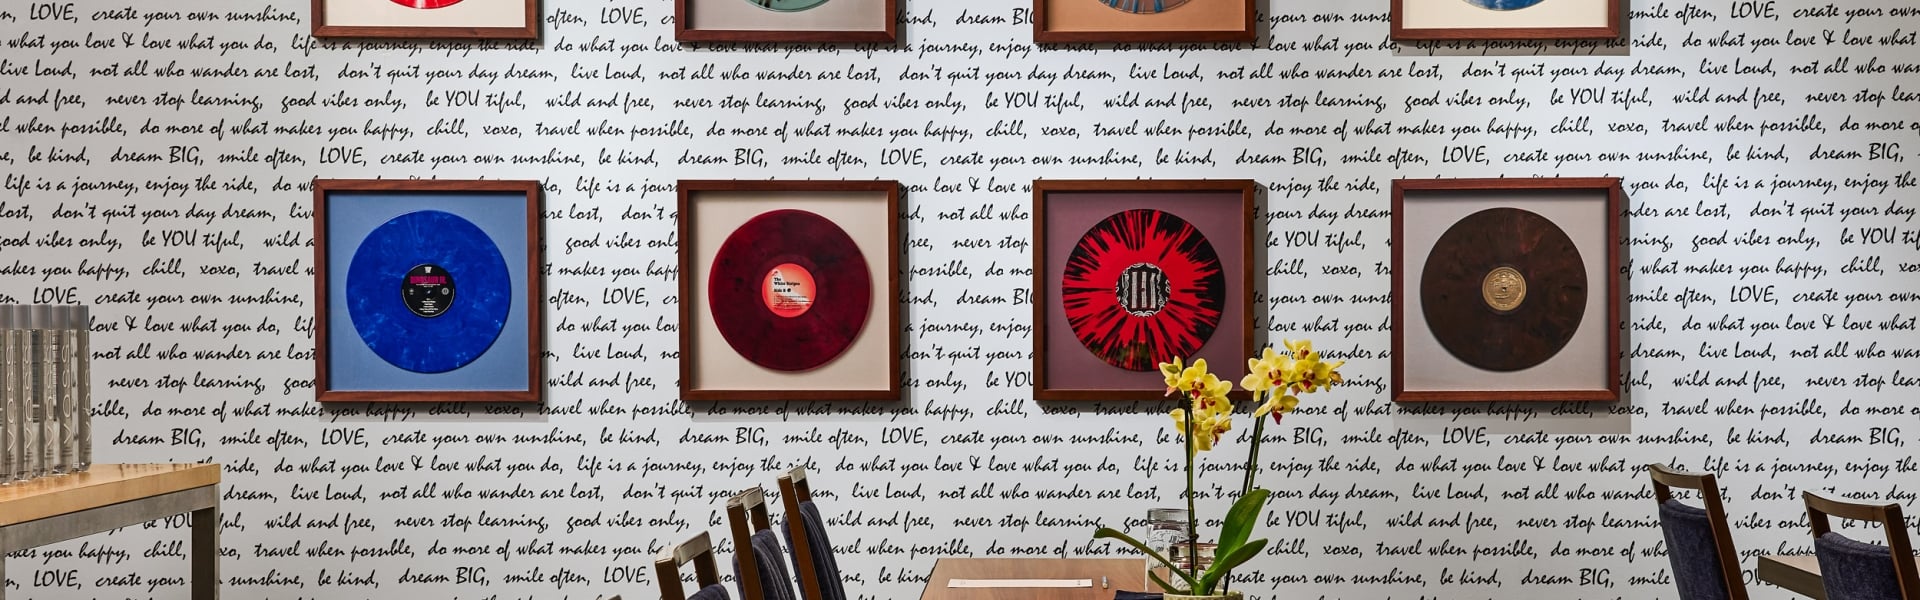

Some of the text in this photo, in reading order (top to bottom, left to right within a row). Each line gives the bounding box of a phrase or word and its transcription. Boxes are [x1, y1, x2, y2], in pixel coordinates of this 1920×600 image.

[30, 2, 300, 27] LOVE, create your own sunshine,
[1629, 0, 1883, 26] smile often, LOVE, create your
[7, 31, 277, 56] what you love & love what you do,
[919, 38, 1032, 60] journey, enjoy
[658, 63, 880, 83] not all who wander are lost,
[1699, 57, 1776, 77] live Loud,
[105, 89, 263, 113] never stop learning,
[985, 90, 1084, 115] be YOU tiful,
[1672, 86, 1785, 110] wild and free,
[140, 118, 468, 142] do more of what makes you happy, chill,
[678, 147, 926, 172] dream BIG, smile often, LOVE,
[4, 173, 257, 198] life is a journey, enjoy the ride,
[1630, 173, 1688, 196] you do,
[52, 202, 276, 225] don't quit your day dream,
[142, 229, 243, 254] be YOU tiful,
[1692, 227, 1820, 252] good vibes only,
[143, 258, 239, 278] chill, xoxo,
[1640, 257, 1827, 280] what makes you happy,
[95, 287, 303, 310] create your own sunshine,
[144, 315, 280, 339] love what you do,
[904, 318, 983, 339] a journey,
[92, 342, 281, 360] not all who wander are
[1698, 341, 1776, 361] live Loud,
[108, 371, 265, 395] never stop learning,
[1672, 369, 1785, 393] wild and free,
[142, 400, 324, 423] do more of what makes
[113, 428, 368, 452] dream BIG, smile often, LOVE,
[835, 455, 1119, 478] do what you love & love what you do,
[290, 483, 366, 503] live Loud,
[938, 482, 1160, 502] not all who wander are lost,
[264, 512, 375, 535] wild and free,
[1266, 509, 1366, 534] be YOU tiful,
[254, 538, 414, 562] travel when possible,
[1267, 538, 1362, 558] chill, xoxo,
[228, 568, 379, 589] sunshine, be kind,
[1440, 567, 1614, 588] be kind, dream BIG,
